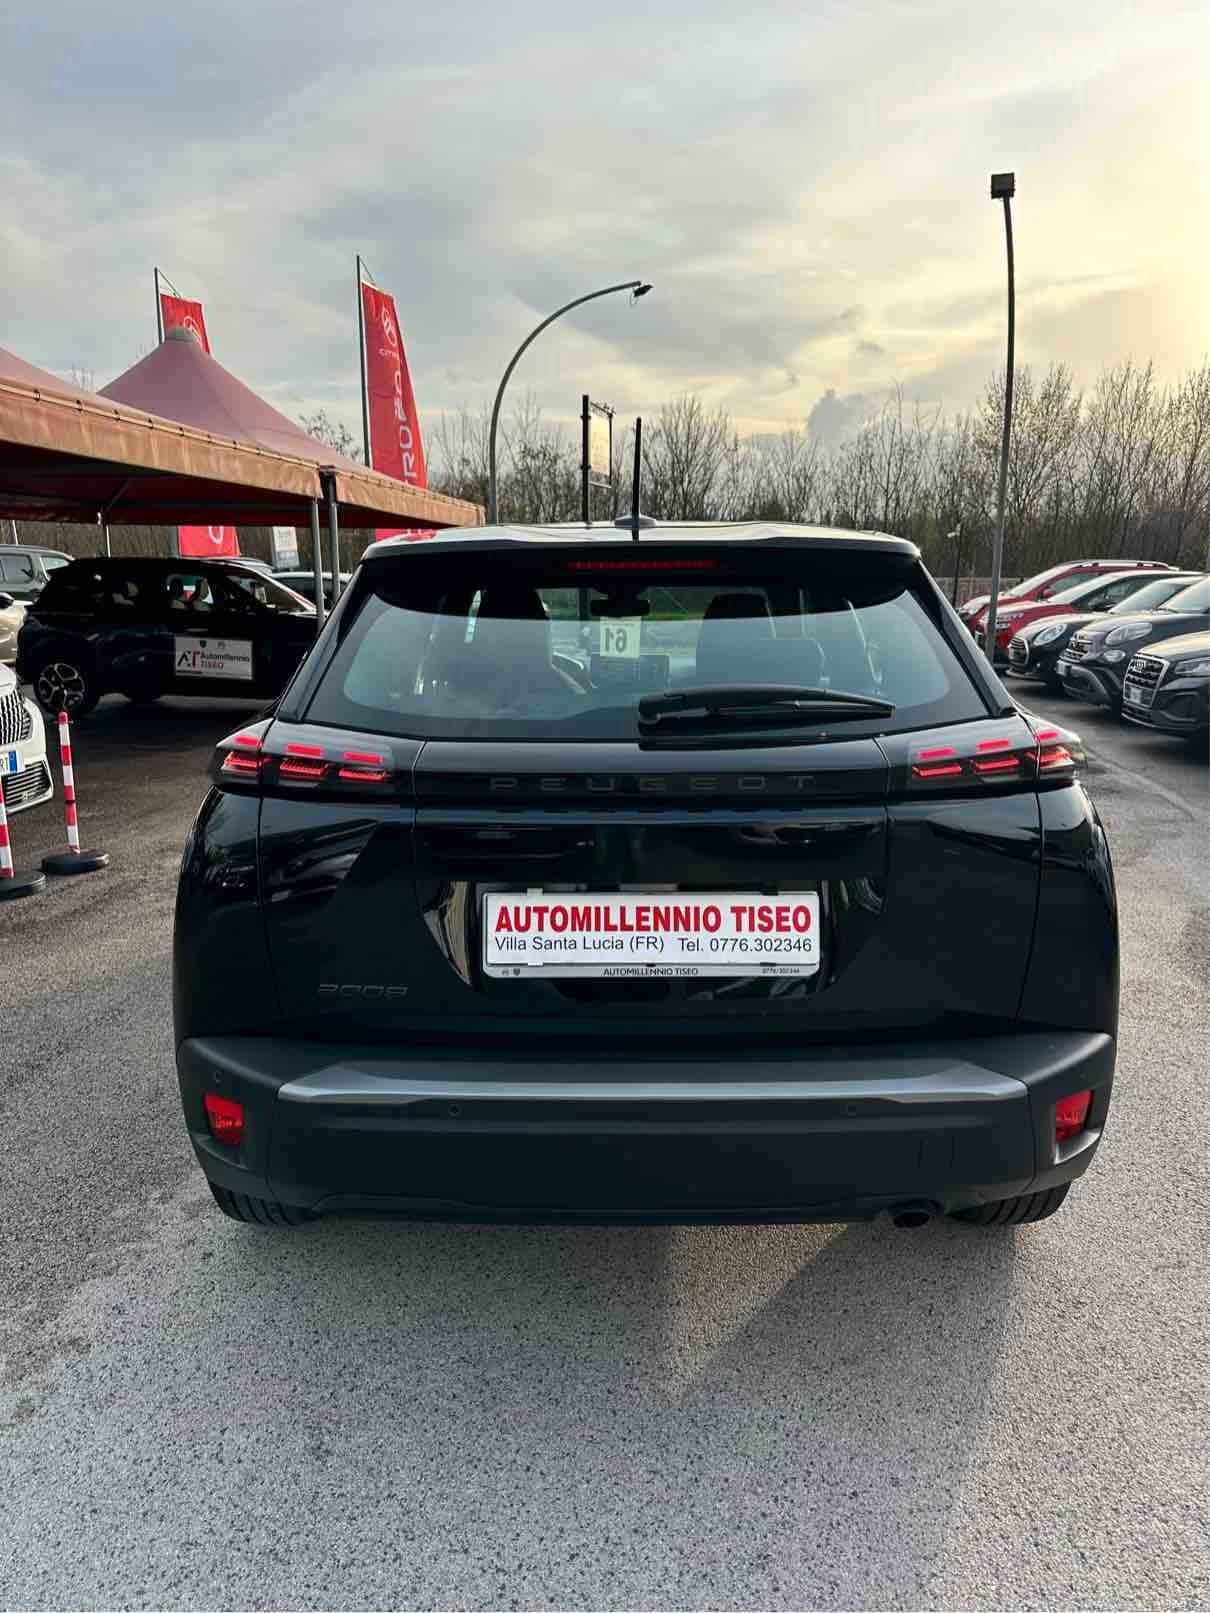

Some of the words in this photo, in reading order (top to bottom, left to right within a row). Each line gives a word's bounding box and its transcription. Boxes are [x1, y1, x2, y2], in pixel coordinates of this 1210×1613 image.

[489, 775, 815, 792] PEUGEOT
[495, 904, 723, 934] AUTOMILLENNIO
[730, 904, 813, 934] TISEO
[495, 936, 530, 952] Villa
[532, 936, 578, 951] Santa
[582, 936, 626, 952] Lucia
[629, 935, 666, 954] (FR)
[677, 937, 705, 952] Tel.
[708, 937, 814, 953] 0776.302346
[603, 967, 673, 977] AUTOMILLENNIO
[674, 967, 699, 976] TISEO
